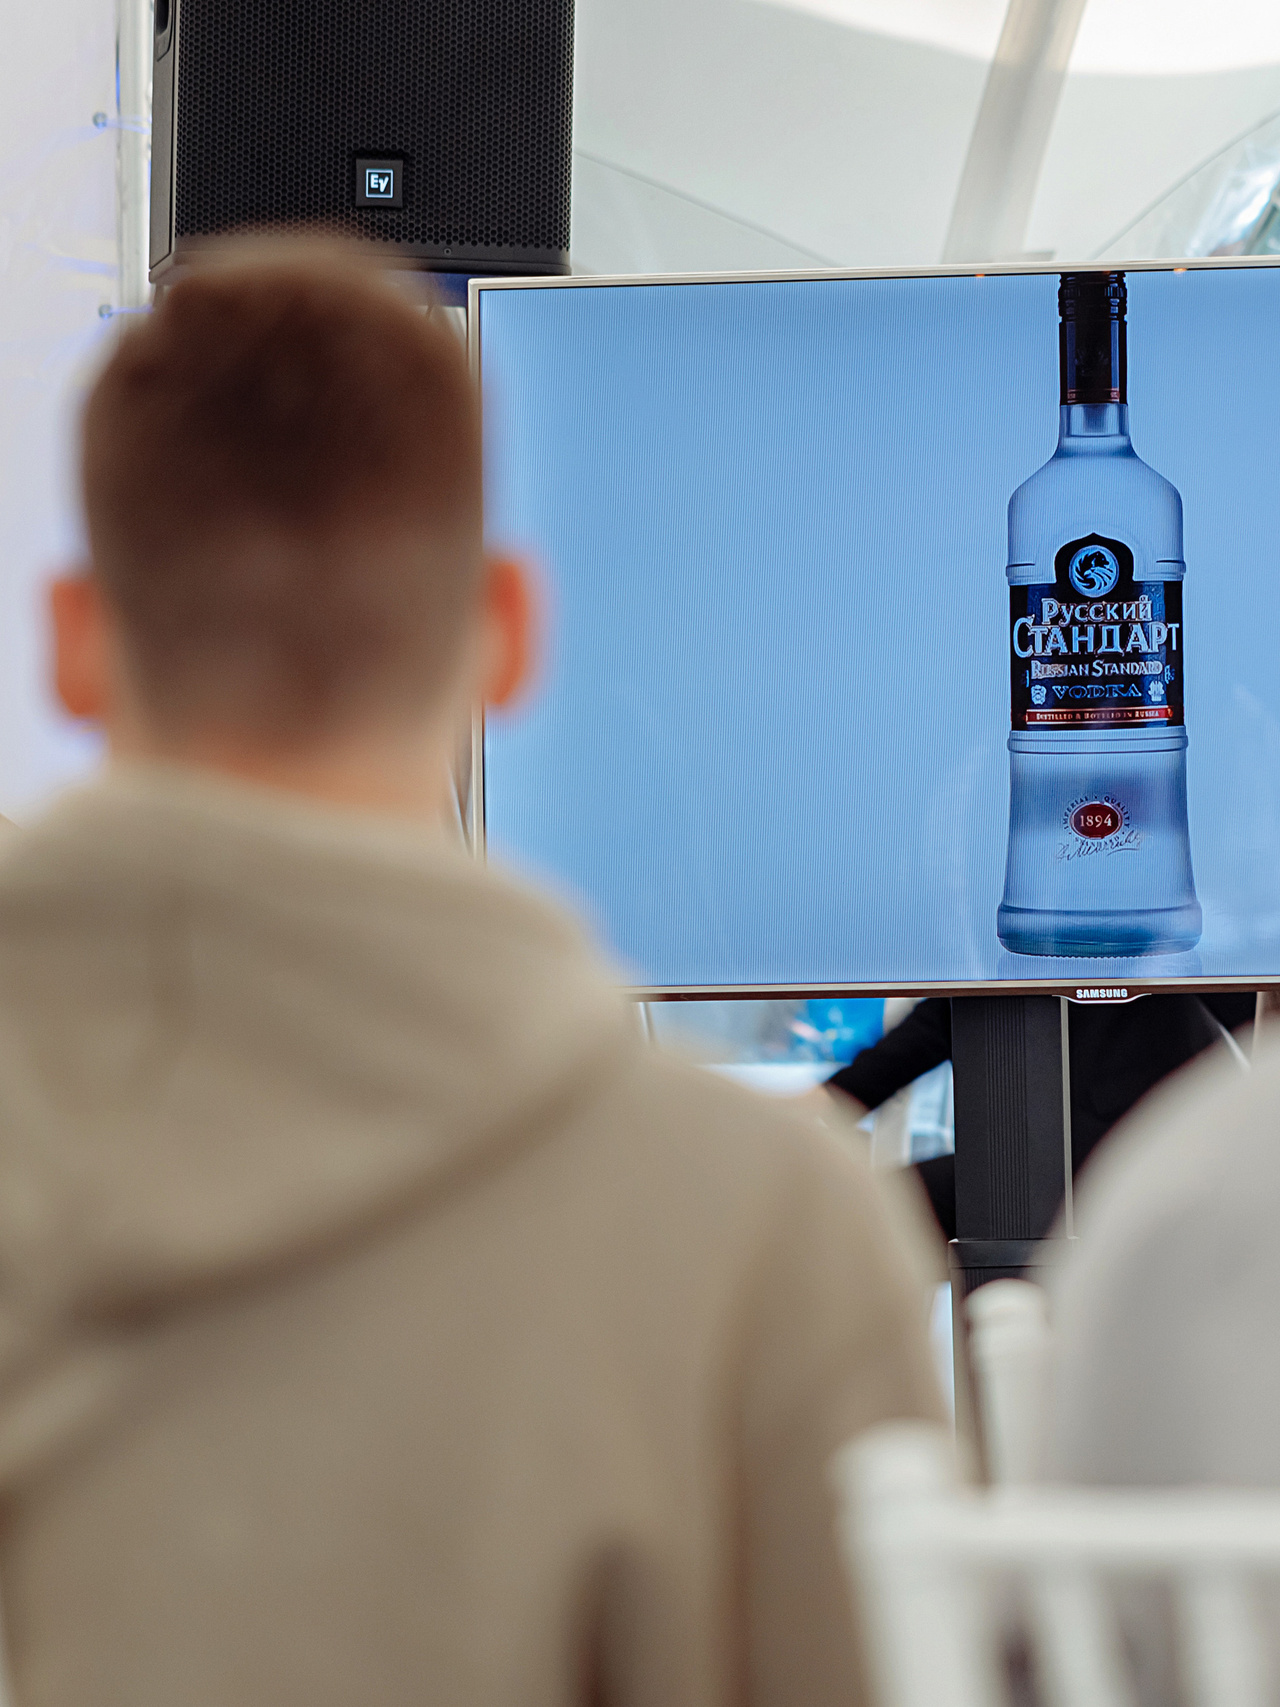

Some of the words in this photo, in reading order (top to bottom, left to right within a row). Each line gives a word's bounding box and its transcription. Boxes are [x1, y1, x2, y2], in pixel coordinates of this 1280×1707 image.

[1052, 682, 1142, 699] VODKA
[1080, 813, 1112, 828] 1894
[1076, 988, 1128, 998] SAMSUNG
